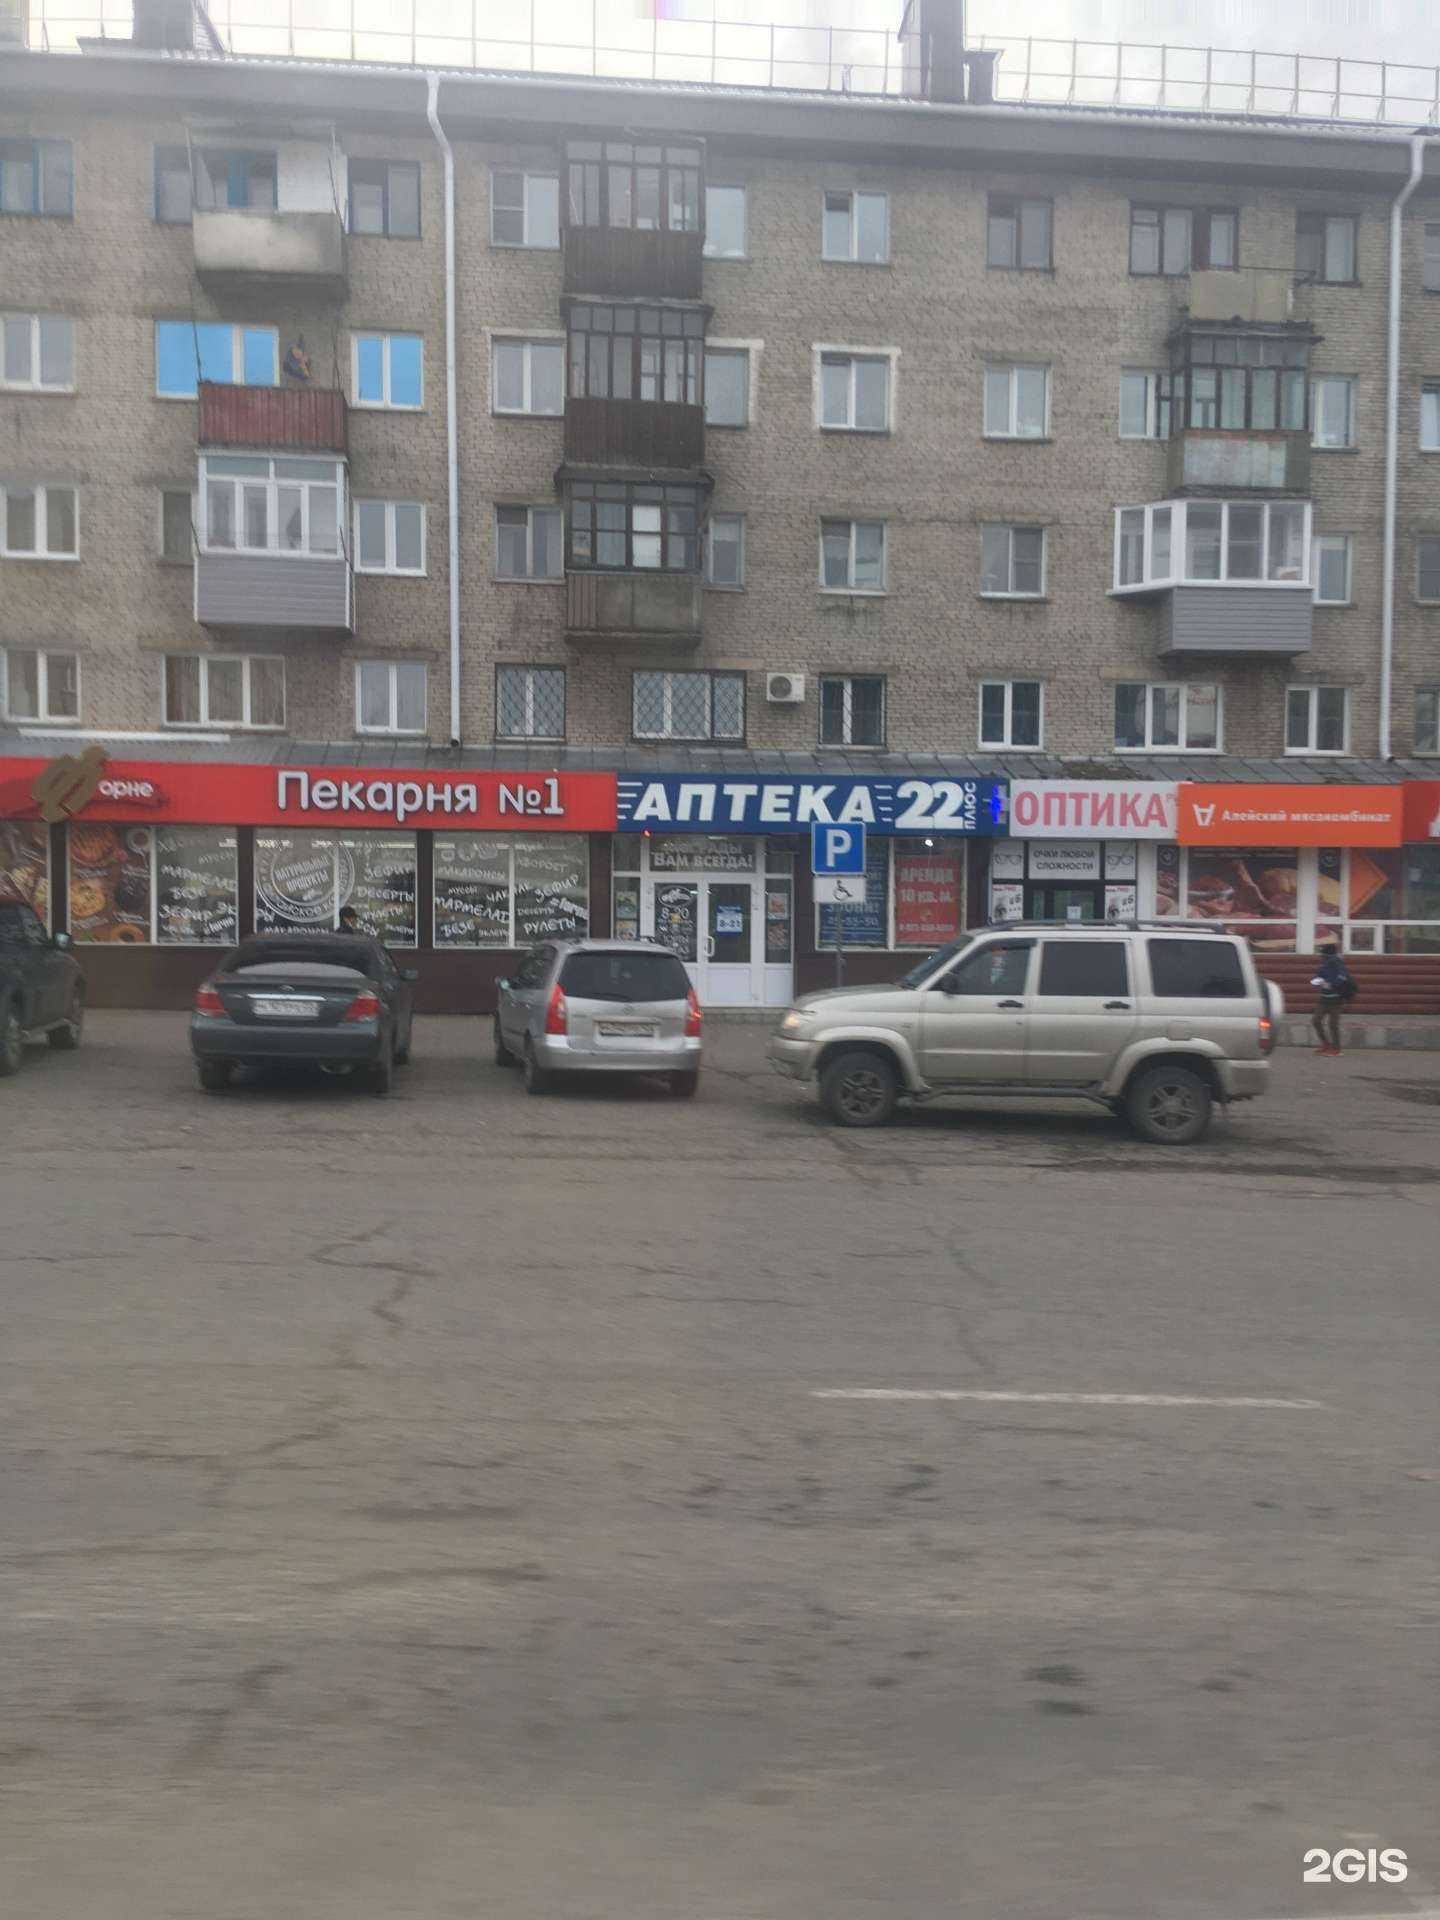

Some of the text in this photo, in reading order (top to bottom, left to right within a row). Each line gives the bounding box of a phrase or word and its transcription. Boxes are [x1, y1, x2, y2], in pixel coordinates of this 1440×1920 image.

[278, 771, 565, 823] Пекарня №1
[632, 780, 965, 831] АПТЕКА 22
[963, 781, 977, 830] ПЛЮС
[1014, 791, 1168, 828] ОПТИКА
[826, 829, 853, 868] P
[1036, 862, 1094, 870] СЛОЖНОСТИ
[523, 915, 577, 936] РУЛЕТЫ
